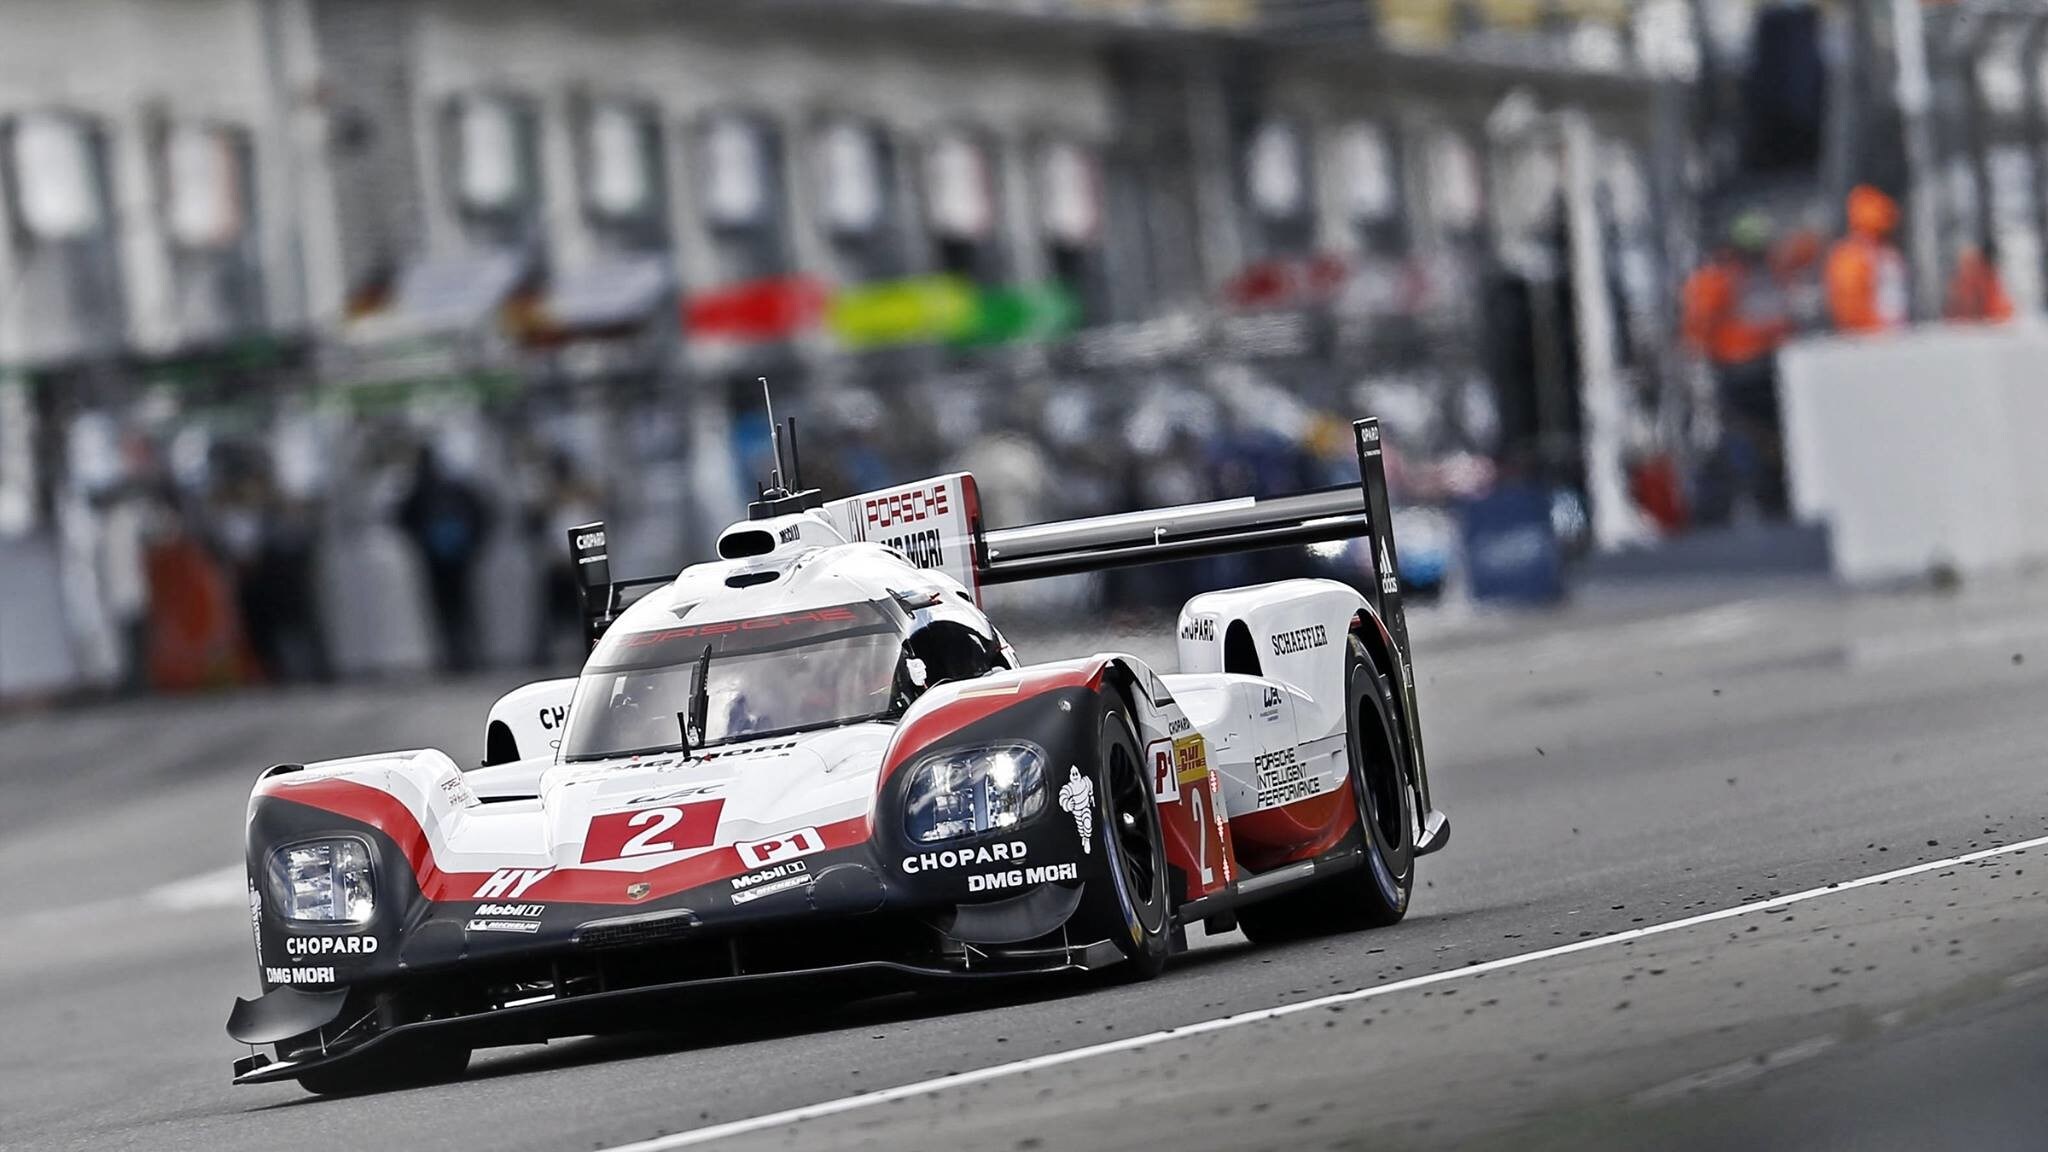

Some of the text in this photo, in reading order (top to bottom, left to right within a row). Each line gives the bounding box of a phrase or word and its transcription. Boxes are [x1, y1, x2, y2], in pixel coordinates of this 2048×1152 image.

[866, 485, 949, 530] PORSCHE
[1271, 624, 1328, 656] SCHAEFFLER
[1155, 750, 1177, 794] P1
[1254, 747, 1296, 774] PORSCHE
[1257, 762, 1307, 791] INTELLIGENT
[1257, 776, 1321, 809] PERFORMANCE
[620, 806, 684, 857] 2
[1191, 787, 1214, 885] 2
[751, 832, 811, 862] P1
[902, 840, 1028, 874] CHOPARD
[471, 868, 557, 899] HY
[731, 866, 787, 890] Mobil
[967, 862, 1079, 892] DMG MORI
[475, 904, 528, 916] Mobil
[286, 936, 379, 955] CHOPARD
[266, 966, 336, 984] DMG MORI
